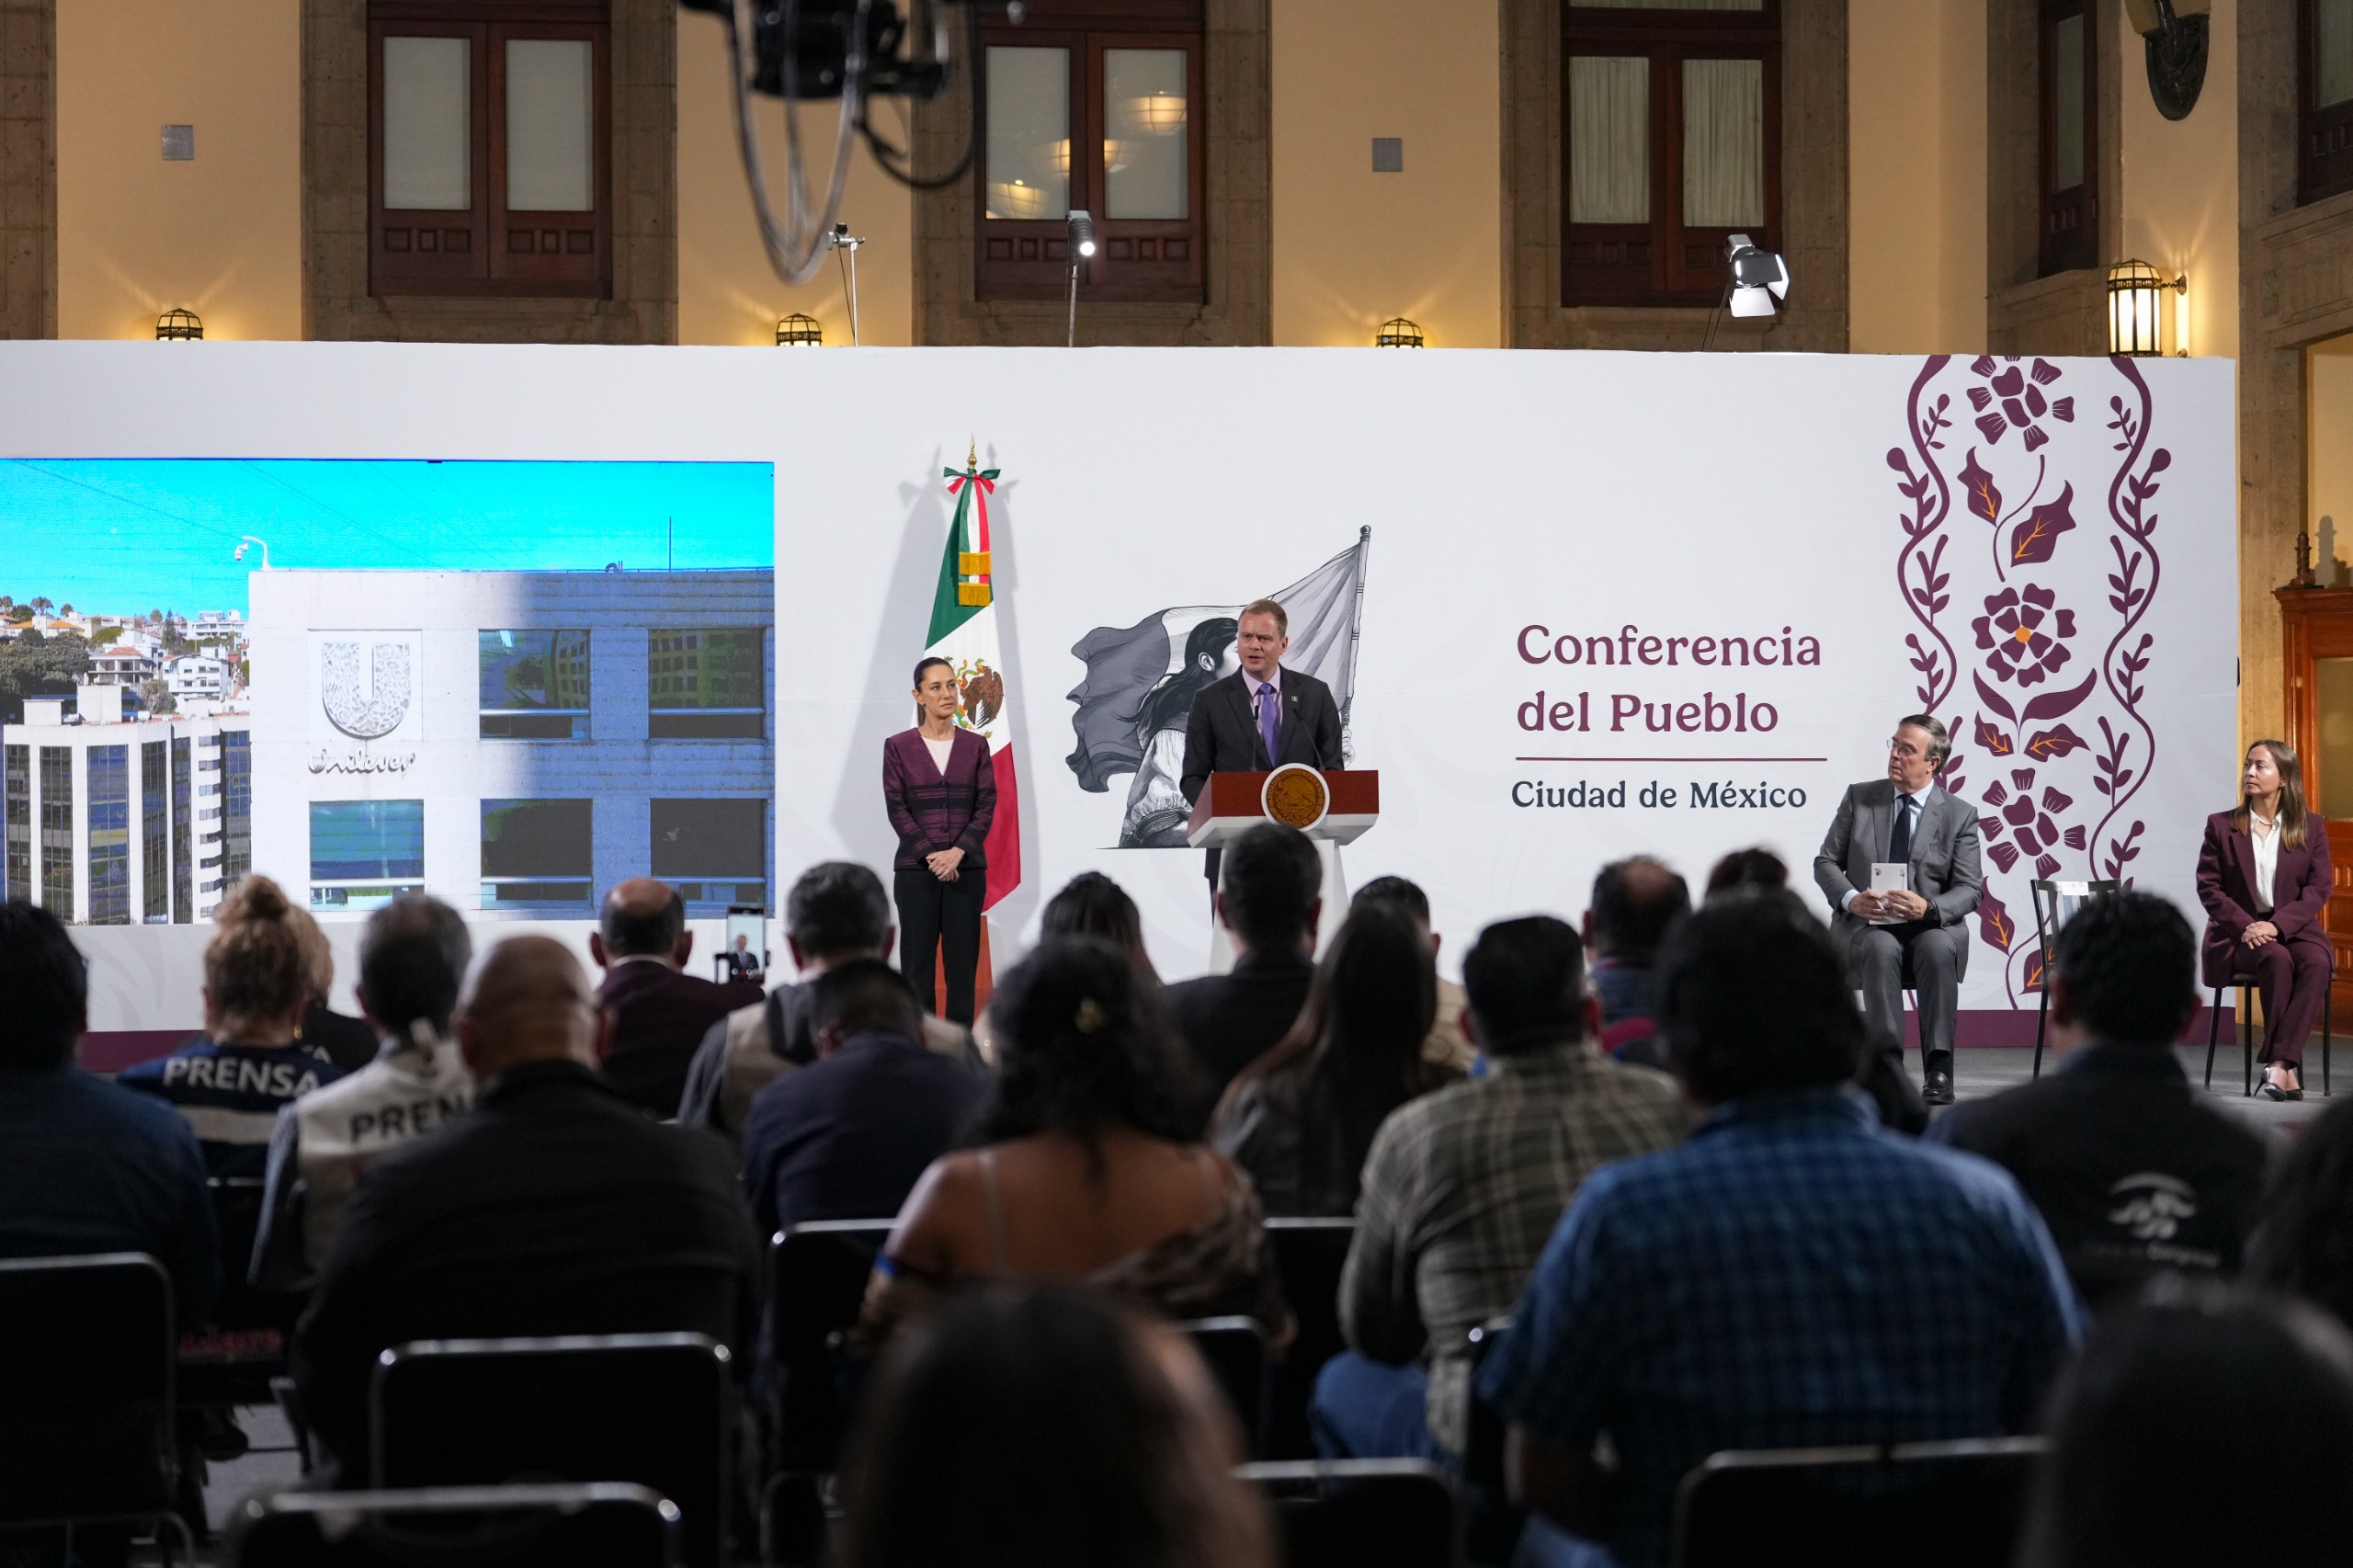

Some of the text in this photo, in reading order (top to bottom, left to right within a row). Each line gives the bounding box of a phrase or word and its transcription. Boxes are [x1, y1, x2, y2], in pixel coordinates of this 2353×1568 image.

[1517, 624, 1821, 665] Conferencia
[1517, 690, 1779, 733] del Pueblo
[1511, 779, 1807, 809] Ciudad de México
[163, 1055, 321, 1096] PRENSA
